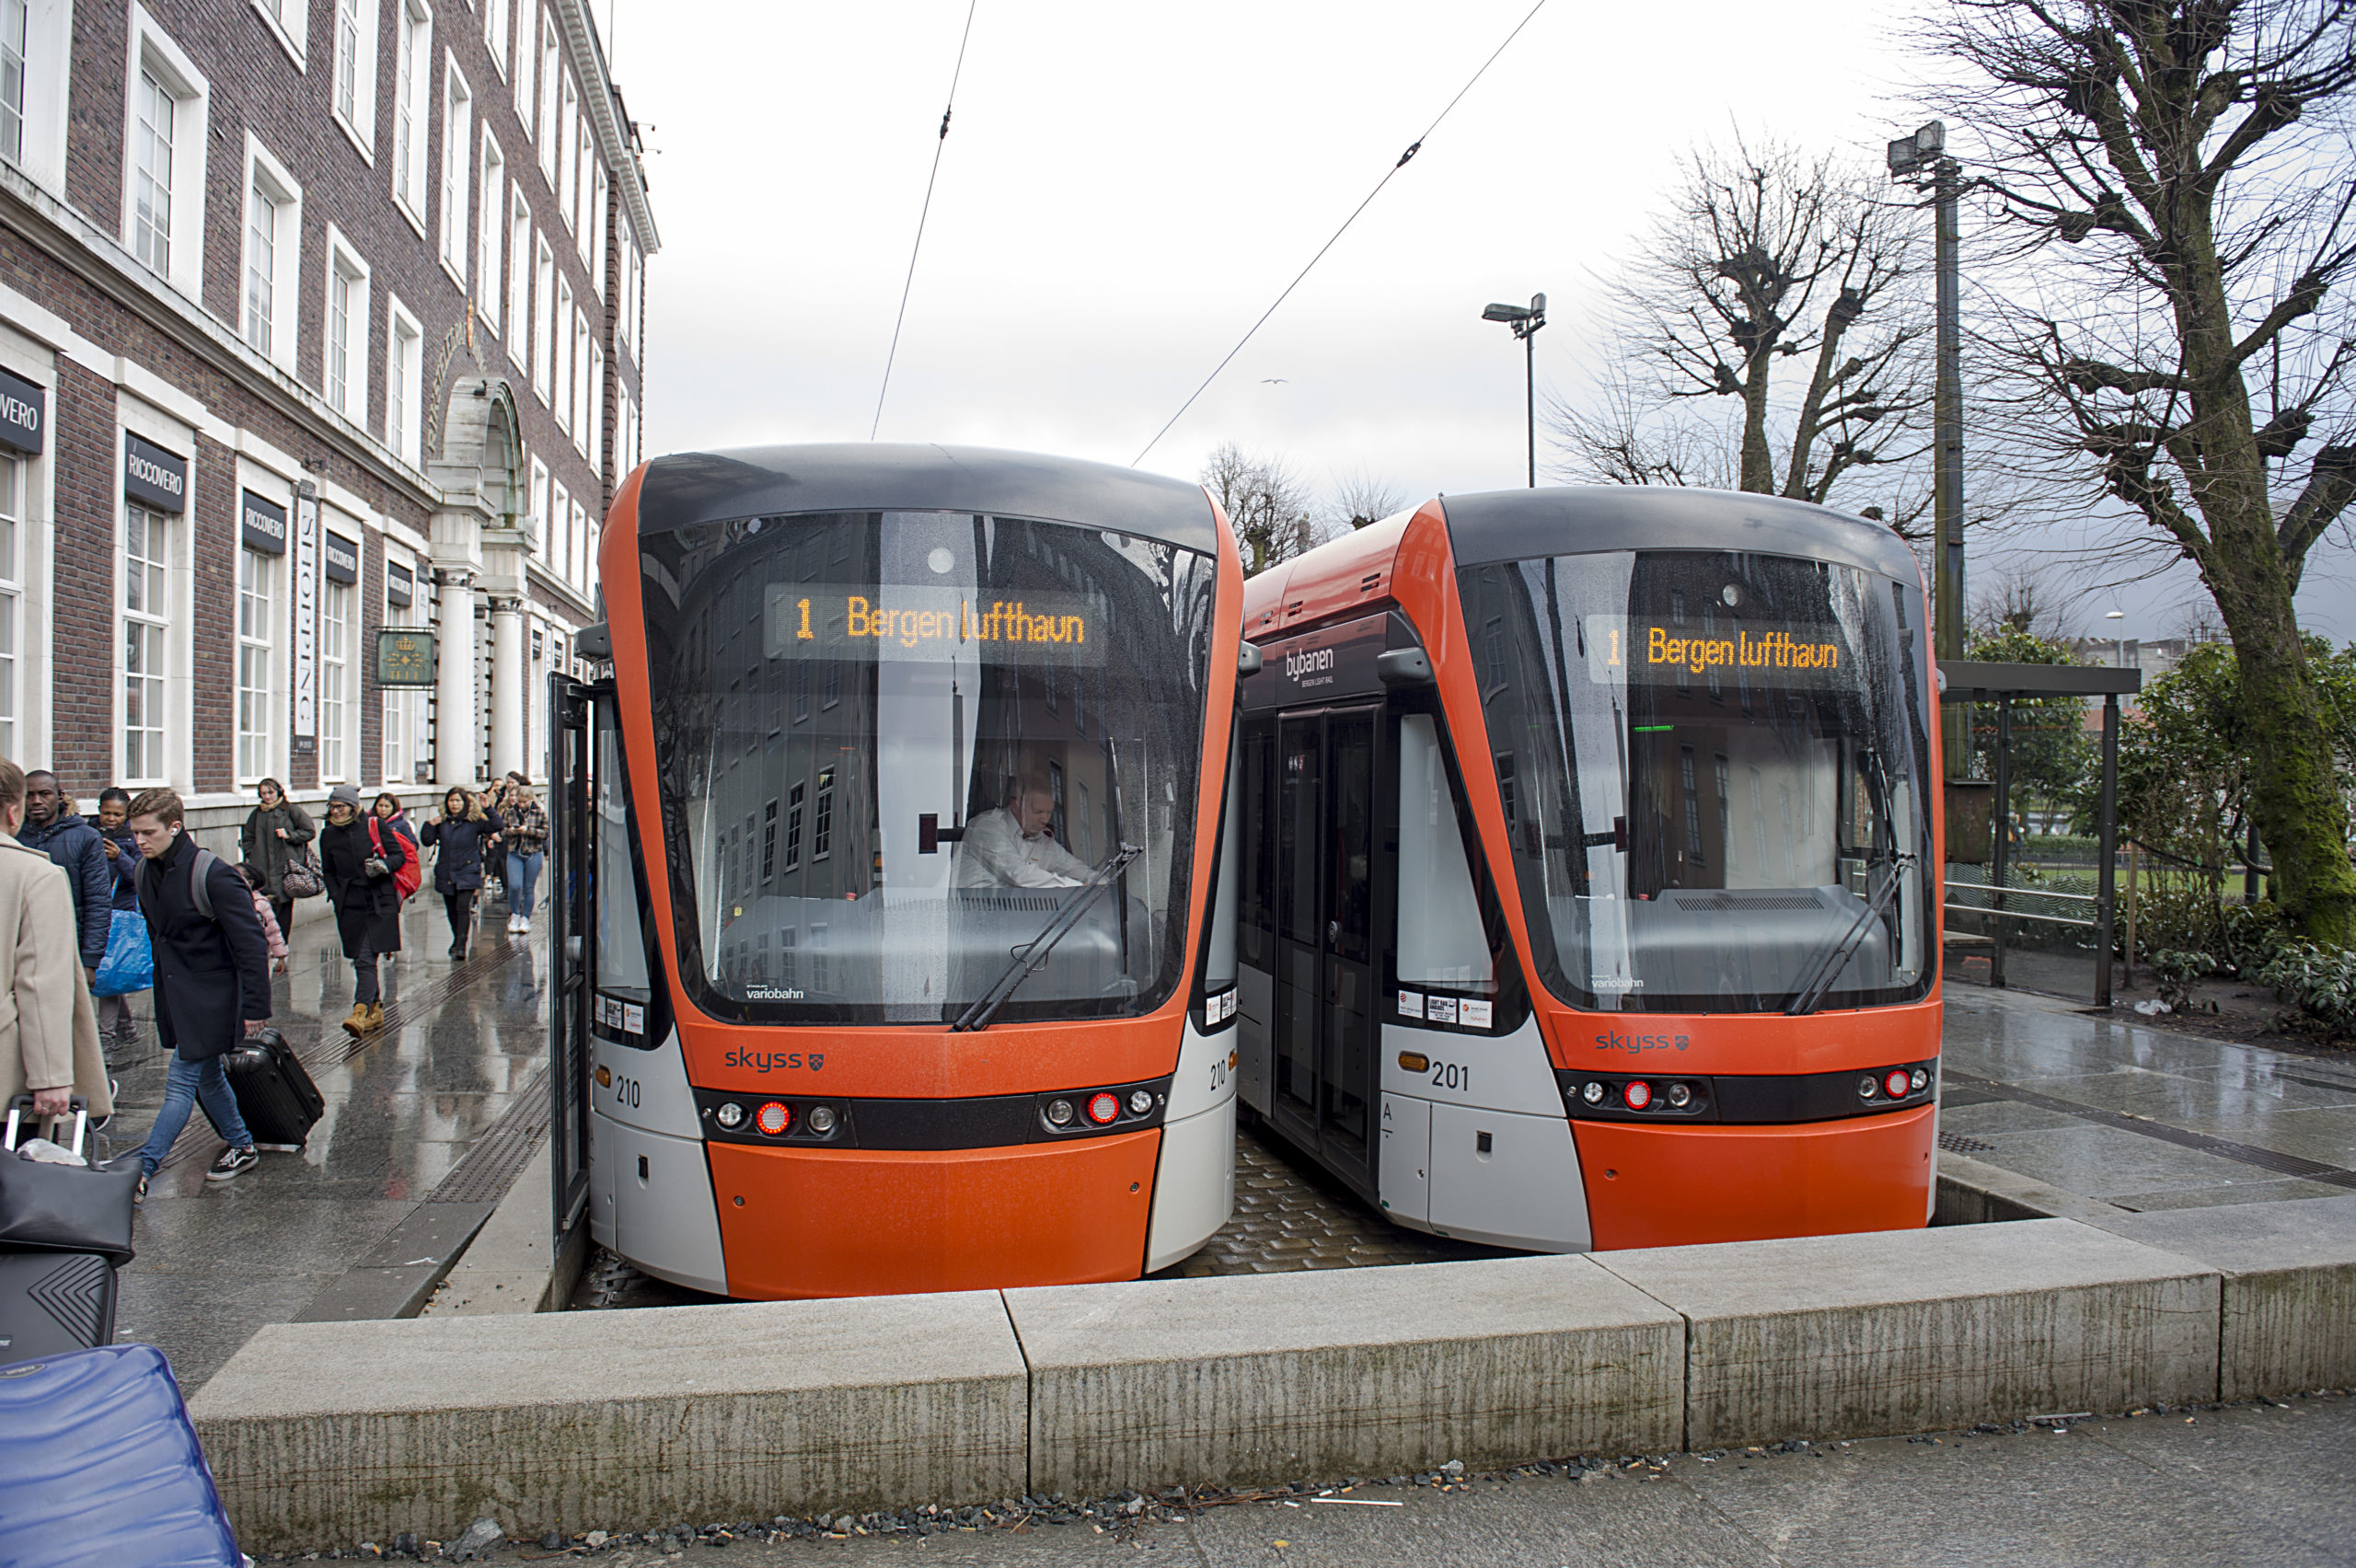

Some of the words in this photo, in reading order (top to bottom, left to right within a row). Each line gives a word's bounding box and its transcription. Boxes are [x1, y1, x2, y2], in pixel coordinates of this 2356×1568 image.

[0, 393, 38, 432] VERO
[129, 454, 183, 495] RICCOVERO
[245, 507, 284, 540] RICCOVERO
[797, 598, 814, 640] 1
[847, 595, 953, 648] Bergen
[1287, 647, 1334, 682] bybanen
[1608, 629, 1621, 665] 1
[1648, 627, 1734, 674] Bergen
[746, 988, 804, 999] variobahn
[1591, 977, 1644, 987] variobahn
[1595, 1030, 1669, 1055] skyss
[724, 1045, 803, 1073] skyss
[1210, 1059, 1226, 1091] 210
[617, 1075, 641, 1109] 210
[1432, 1061, 1469, 1091] 201
[1383, 1102, 1392, 1121] A
